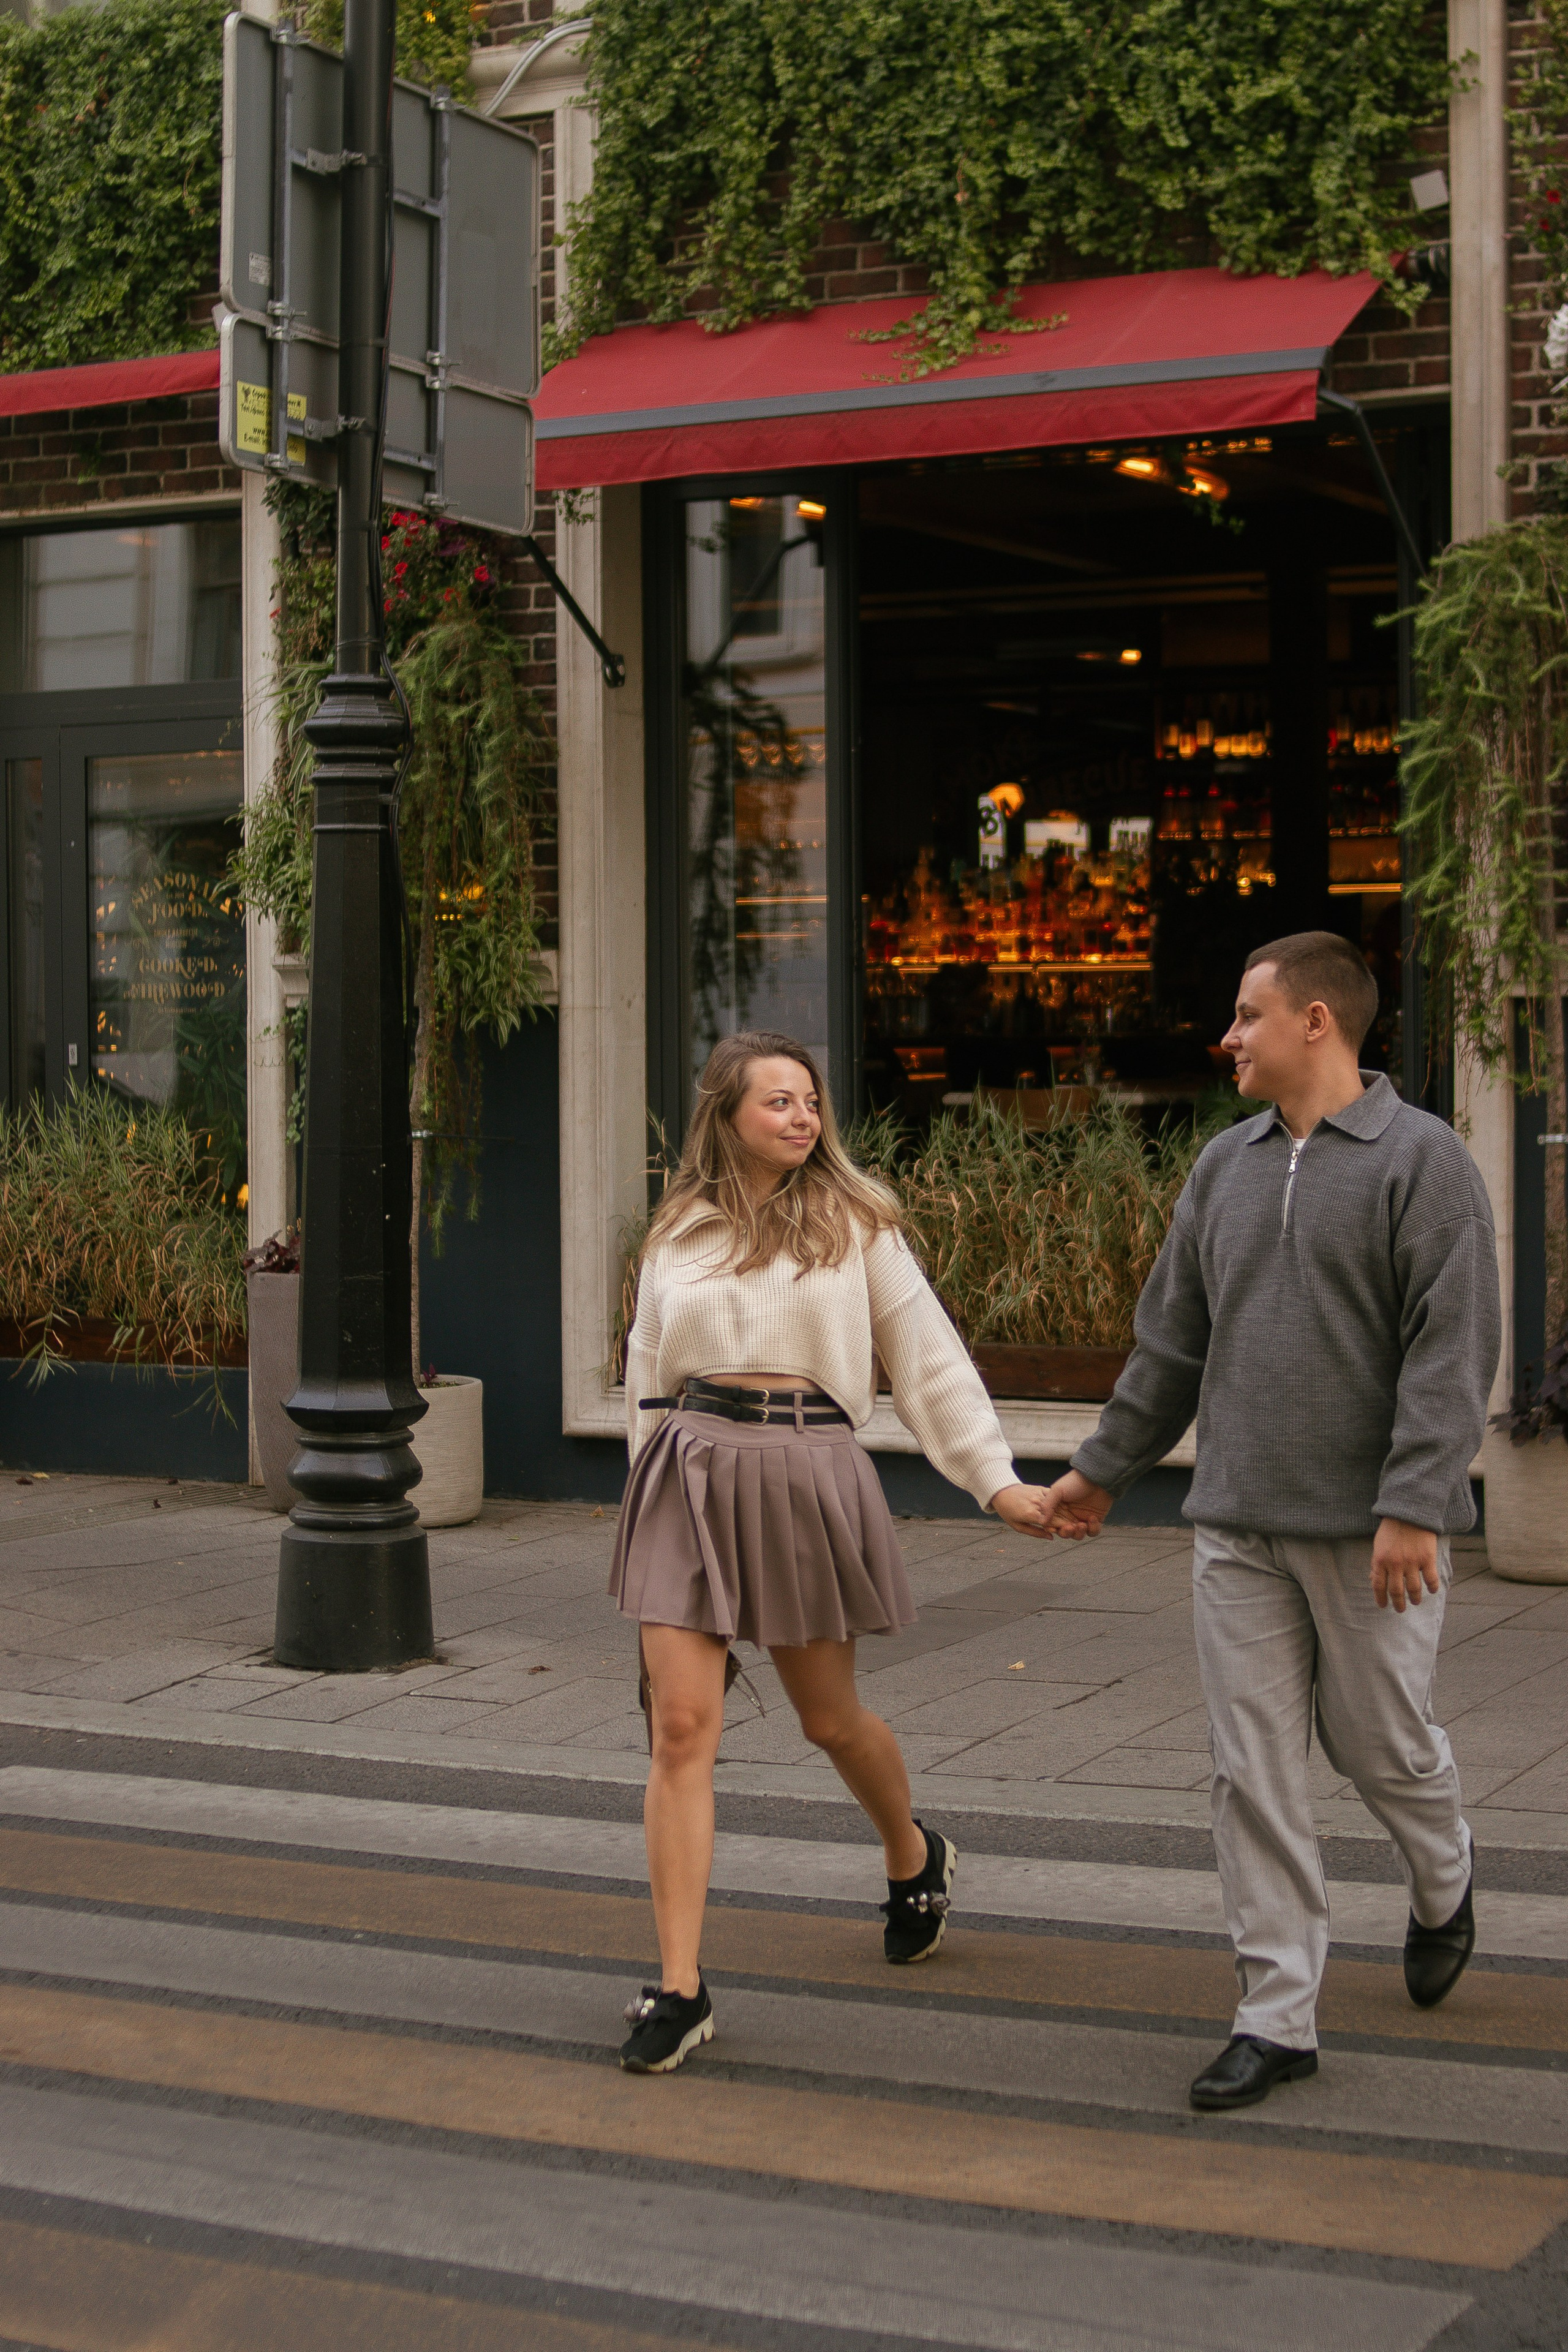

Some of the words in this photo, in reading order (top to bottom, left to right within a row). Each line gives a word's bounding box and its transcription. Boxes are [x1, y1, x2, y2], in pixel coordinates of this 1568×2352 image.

[132, 871, 219, 910] SEASONAL
[148, 902, 203, 924] FOOD
[138, 956, 215, 979] COOKED
[131, 981, 225, 1004] FIREWOOD
